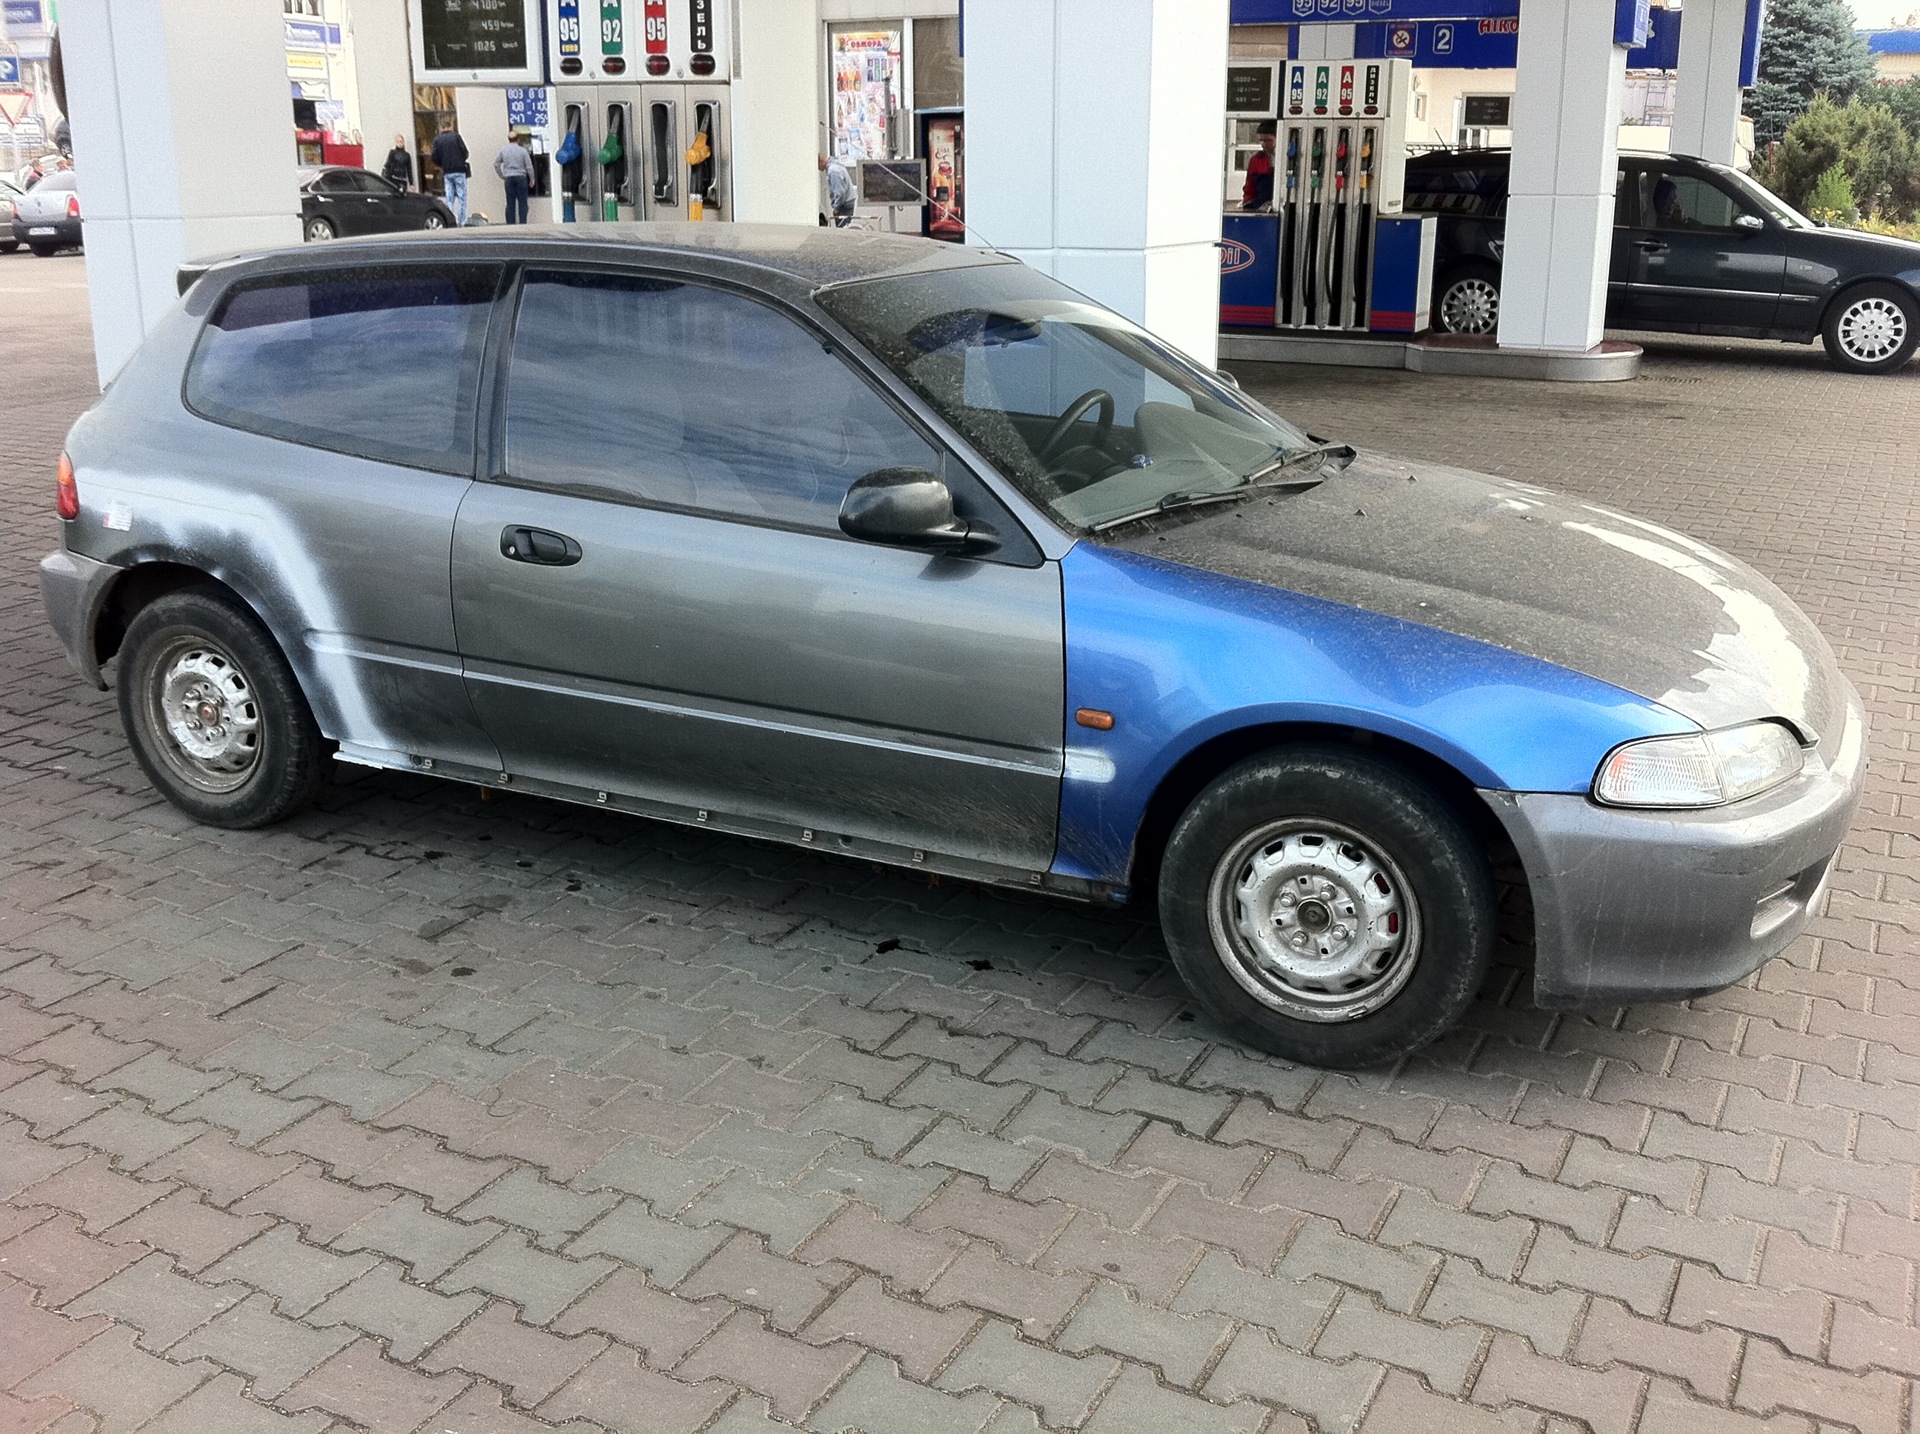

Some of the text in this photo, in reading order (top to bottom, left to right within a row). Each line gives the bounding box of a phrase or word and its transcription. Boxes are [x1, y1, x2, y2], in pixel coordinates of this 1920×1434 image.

[559, 18, 579, 41] 95
[602, 19, 621, 42] 92
[646, 17, 666, 41] 95
[1436, 28, 1451, 50] 2
[1293, 71, 1302, 83] A
[1318, 71, 1327, 83] A
[1343, 71, 1352, 83] A
[1291, 88, 1303, 100] 95
[1316, 88, 1328, 100] 92
[1341, 88, 1353, 100] 95
